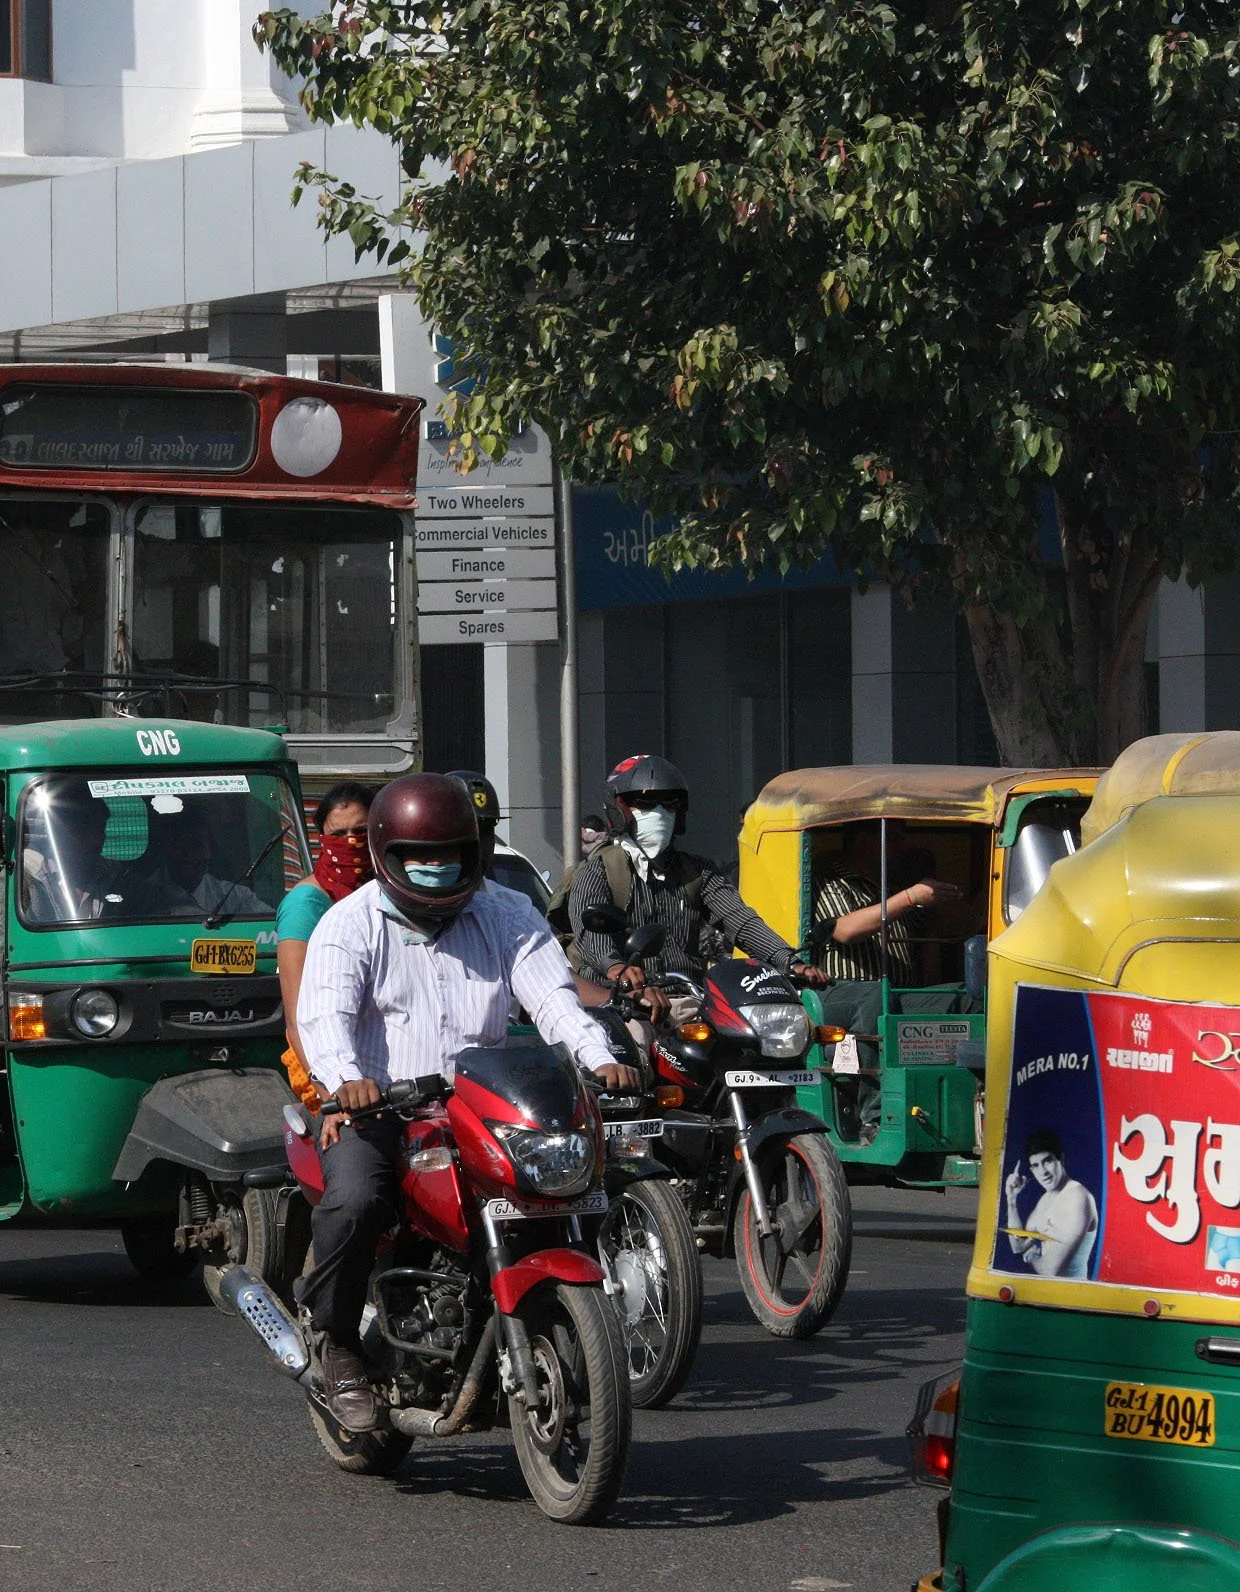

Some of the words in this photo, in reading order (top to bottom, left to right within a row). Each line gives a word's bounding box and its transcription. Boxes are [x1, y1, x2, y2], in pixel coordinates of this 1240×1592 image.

[427, 495, 457, 510] Two
[461, 494, 525, 510] Wheelers
[417, 526, 489, 541] ommercial
[491, 525, 548, 540] Vehicles
[451, 558, 505, 573] Finance
[455, 588, 505, 604] Service
[458, 620, 505, 637] Spares
[136, 729, 181, 756] CNG
[189, 1009, 254, 1024] BAJAJ
[902, 1026, 933, 1039] CNG
[1016, 1055, 1054, 1086] MERA
[1058, 1052, 1090, 1071] NO.1
[792, 1071, 815, 1084] 2183
[638, 1122, 661, 1136] 3882
[1110, 1412, 1148, 1435] BU
[1146, 1392, 1213, 1444] 4994
